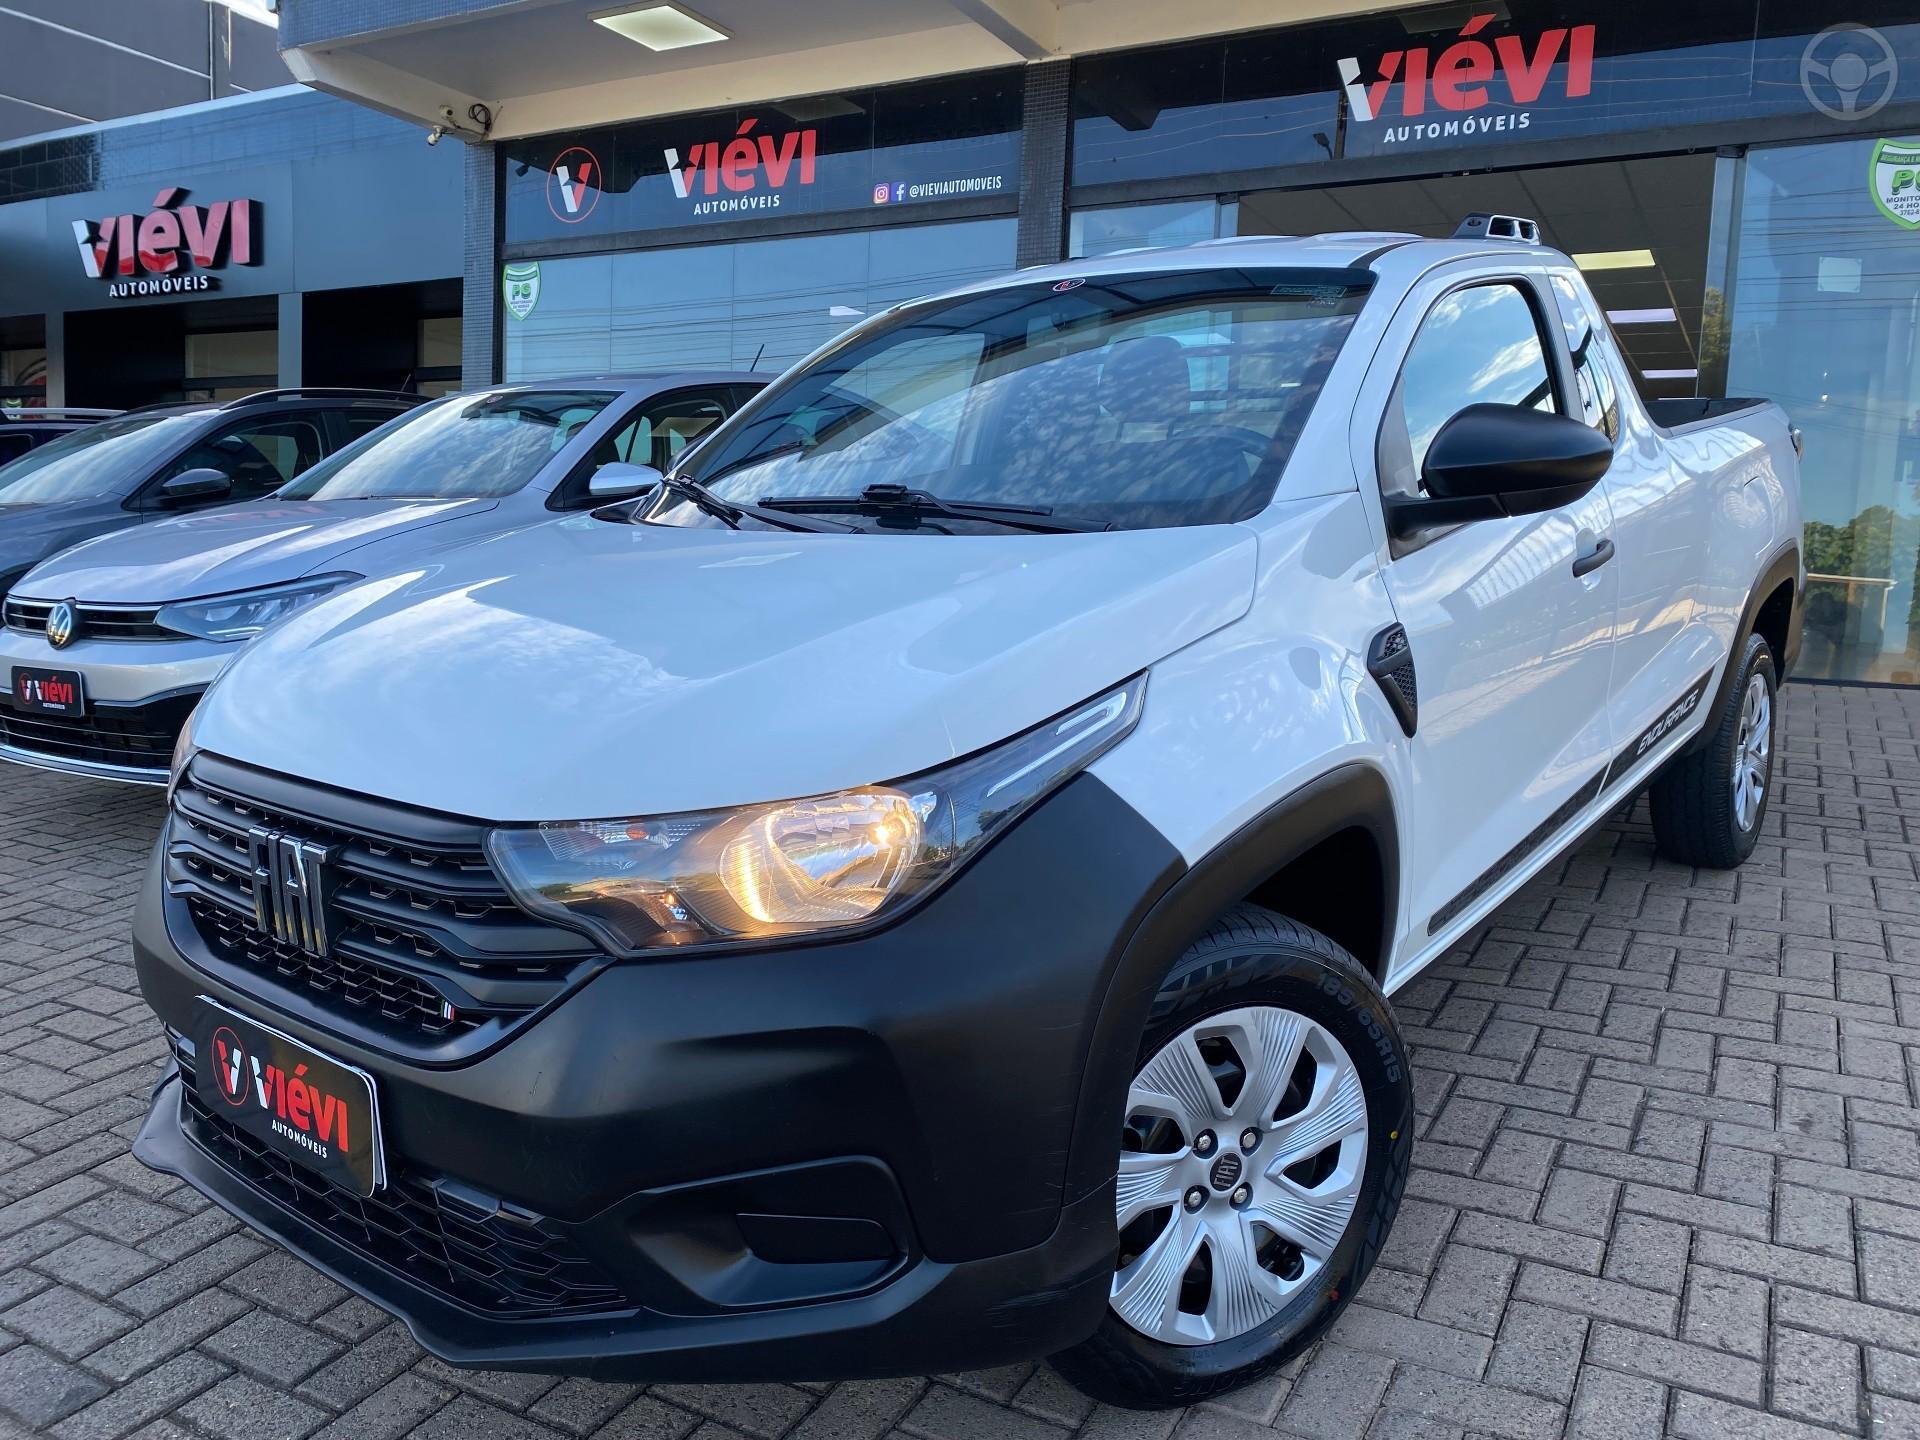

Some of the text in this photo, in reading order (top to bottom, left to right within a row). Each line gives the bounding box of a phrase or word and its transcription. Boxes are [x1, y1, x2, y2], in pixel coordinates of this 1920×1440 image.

[1383, 112, 1531, 143] AUTOMÓVEIS
[909, 175, 1002, 198] @VIEVIAUTOMOVEIS
[1891, 170, 1920, 195] P
[693, 194, 780, 215] AUTOMÓVEIS
[109, 274, 208, 298] AUTOMÓVEIS
[249, 826, 327, 957] FIAT
[271, 1119, 328, 1159] AUTOMÓVEIS
[1213, 1156, 1239, 1188] FIAT
